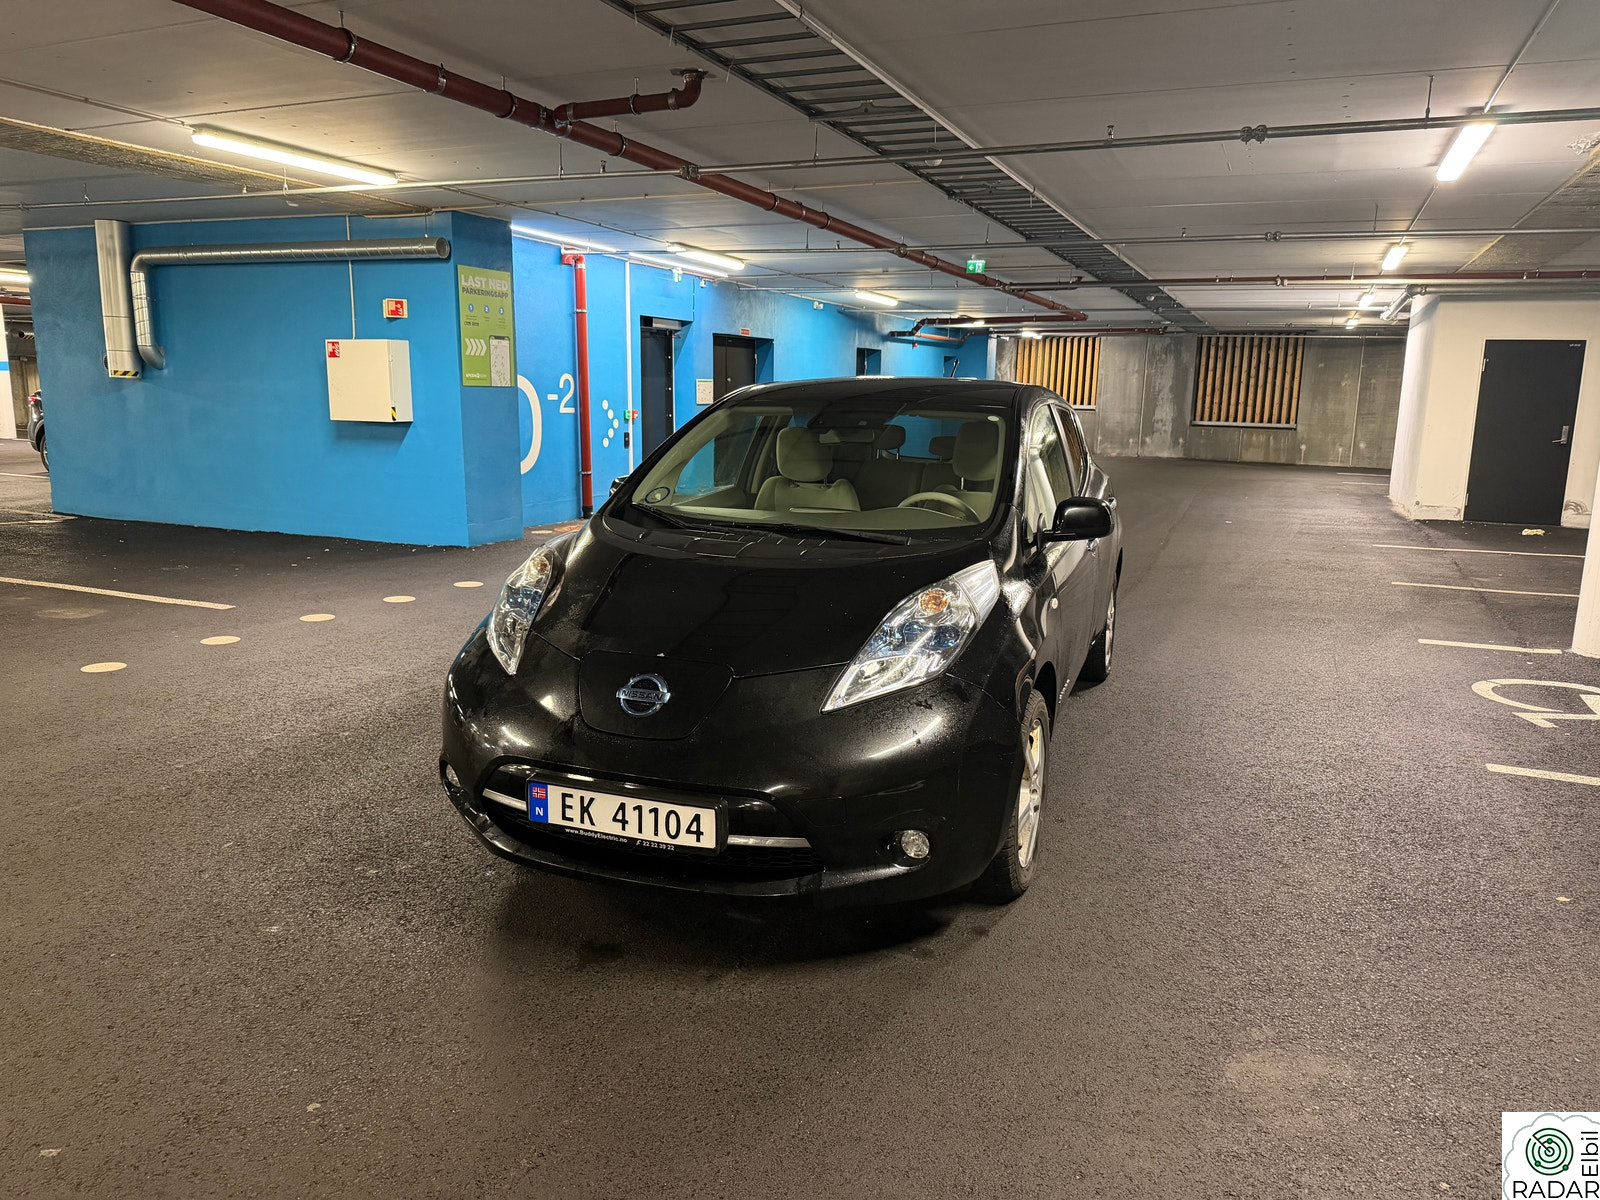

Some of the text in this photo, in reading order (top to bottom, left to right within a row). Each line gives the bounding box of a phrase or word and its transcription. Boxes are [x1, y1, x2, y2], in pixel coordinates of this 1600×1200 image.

[461, 274, 509, 291] LAST NED
[462, 287, 509, 299] PARKERINGSAPP
[621, 689, 663, 701] NISSAN
[535, 807, 544, 816] N
[561, 792, 704, 843] EK 41104
[565, 827, 628, 844] www.BuddyElectric.no
